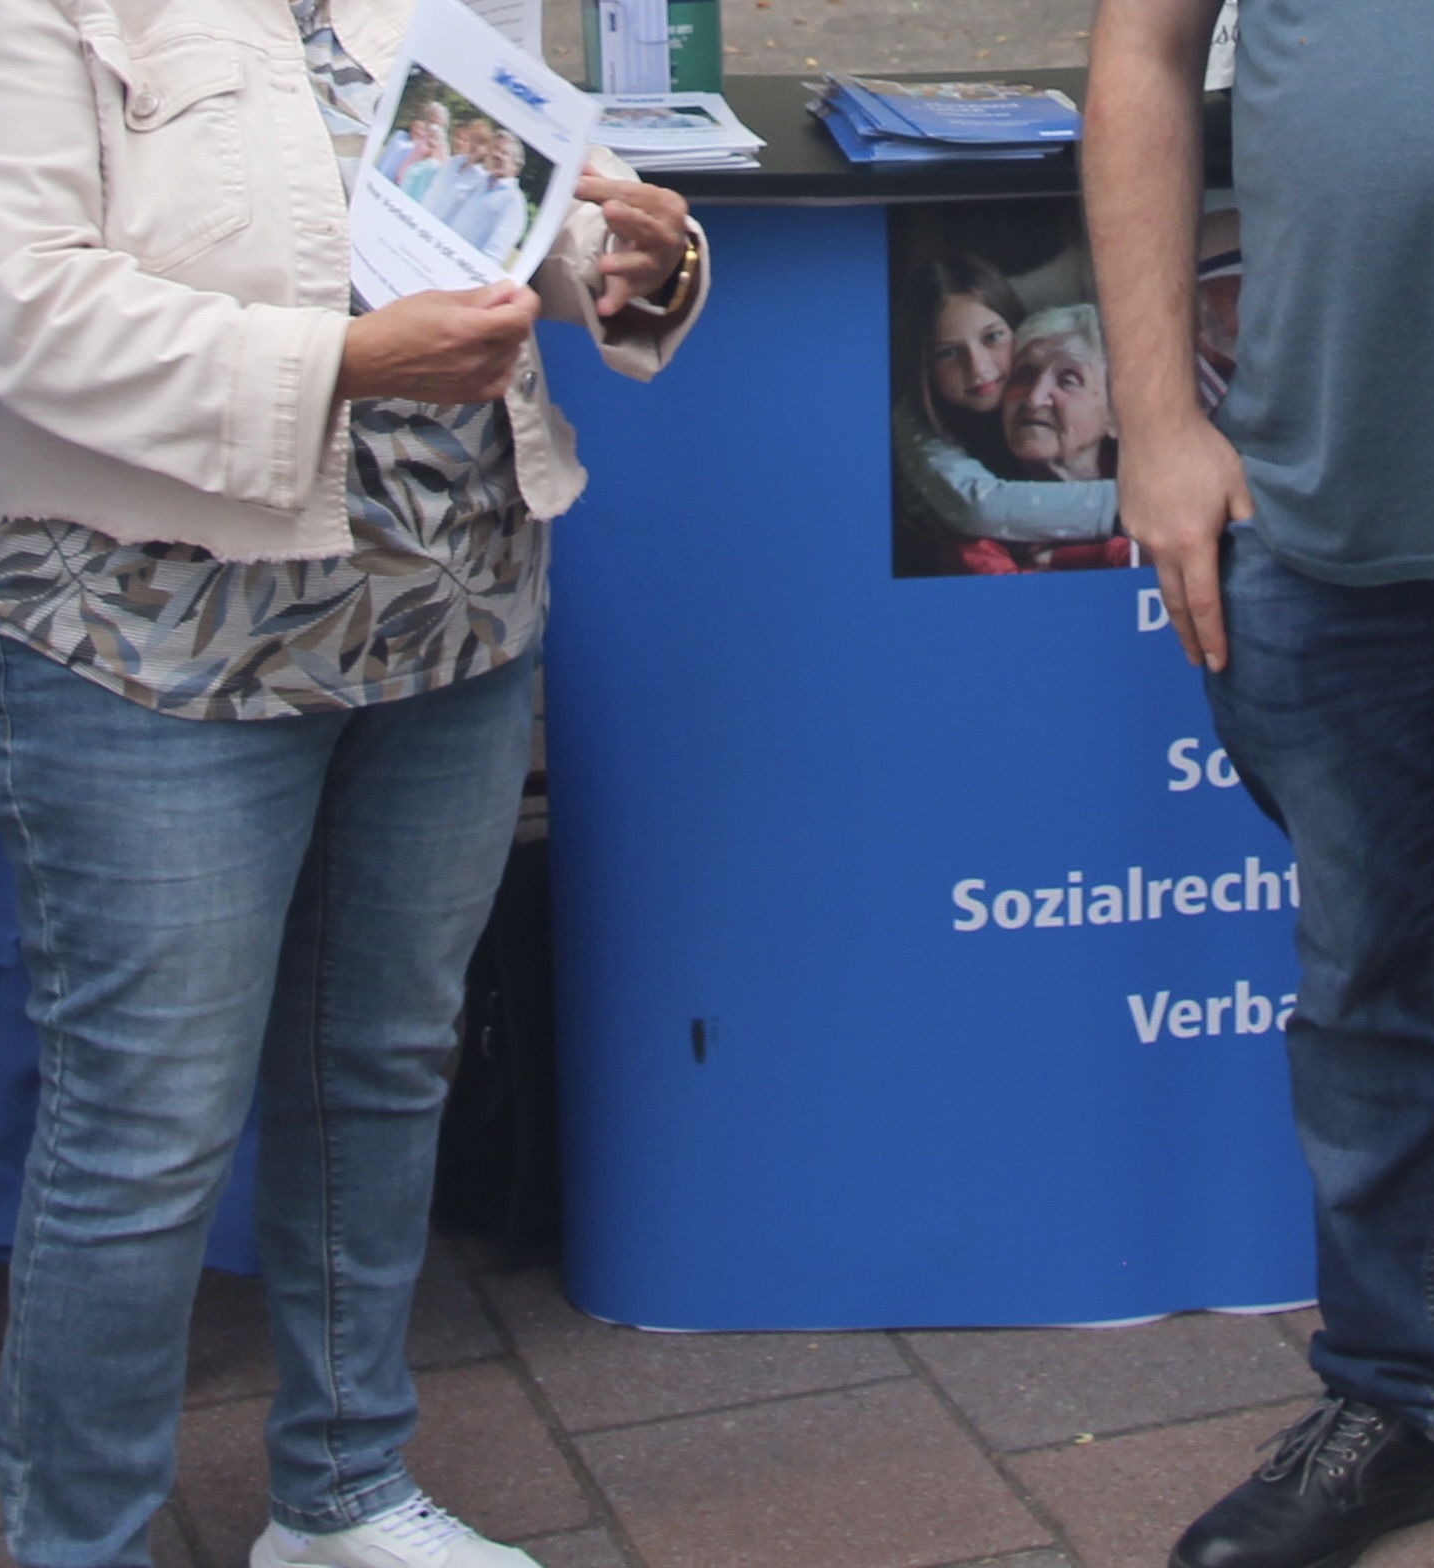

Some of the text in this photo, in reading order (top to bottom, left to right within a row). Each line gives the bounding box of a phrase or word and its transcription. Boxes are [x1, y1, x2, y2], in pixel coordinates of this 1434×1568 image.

[1137, 588, 1171, 633] D
[1167, 737, 1242, 792] So
[951, 856, 1300, 932] Sozialrecht
[1126, 981, 1298, 1044] Verba
